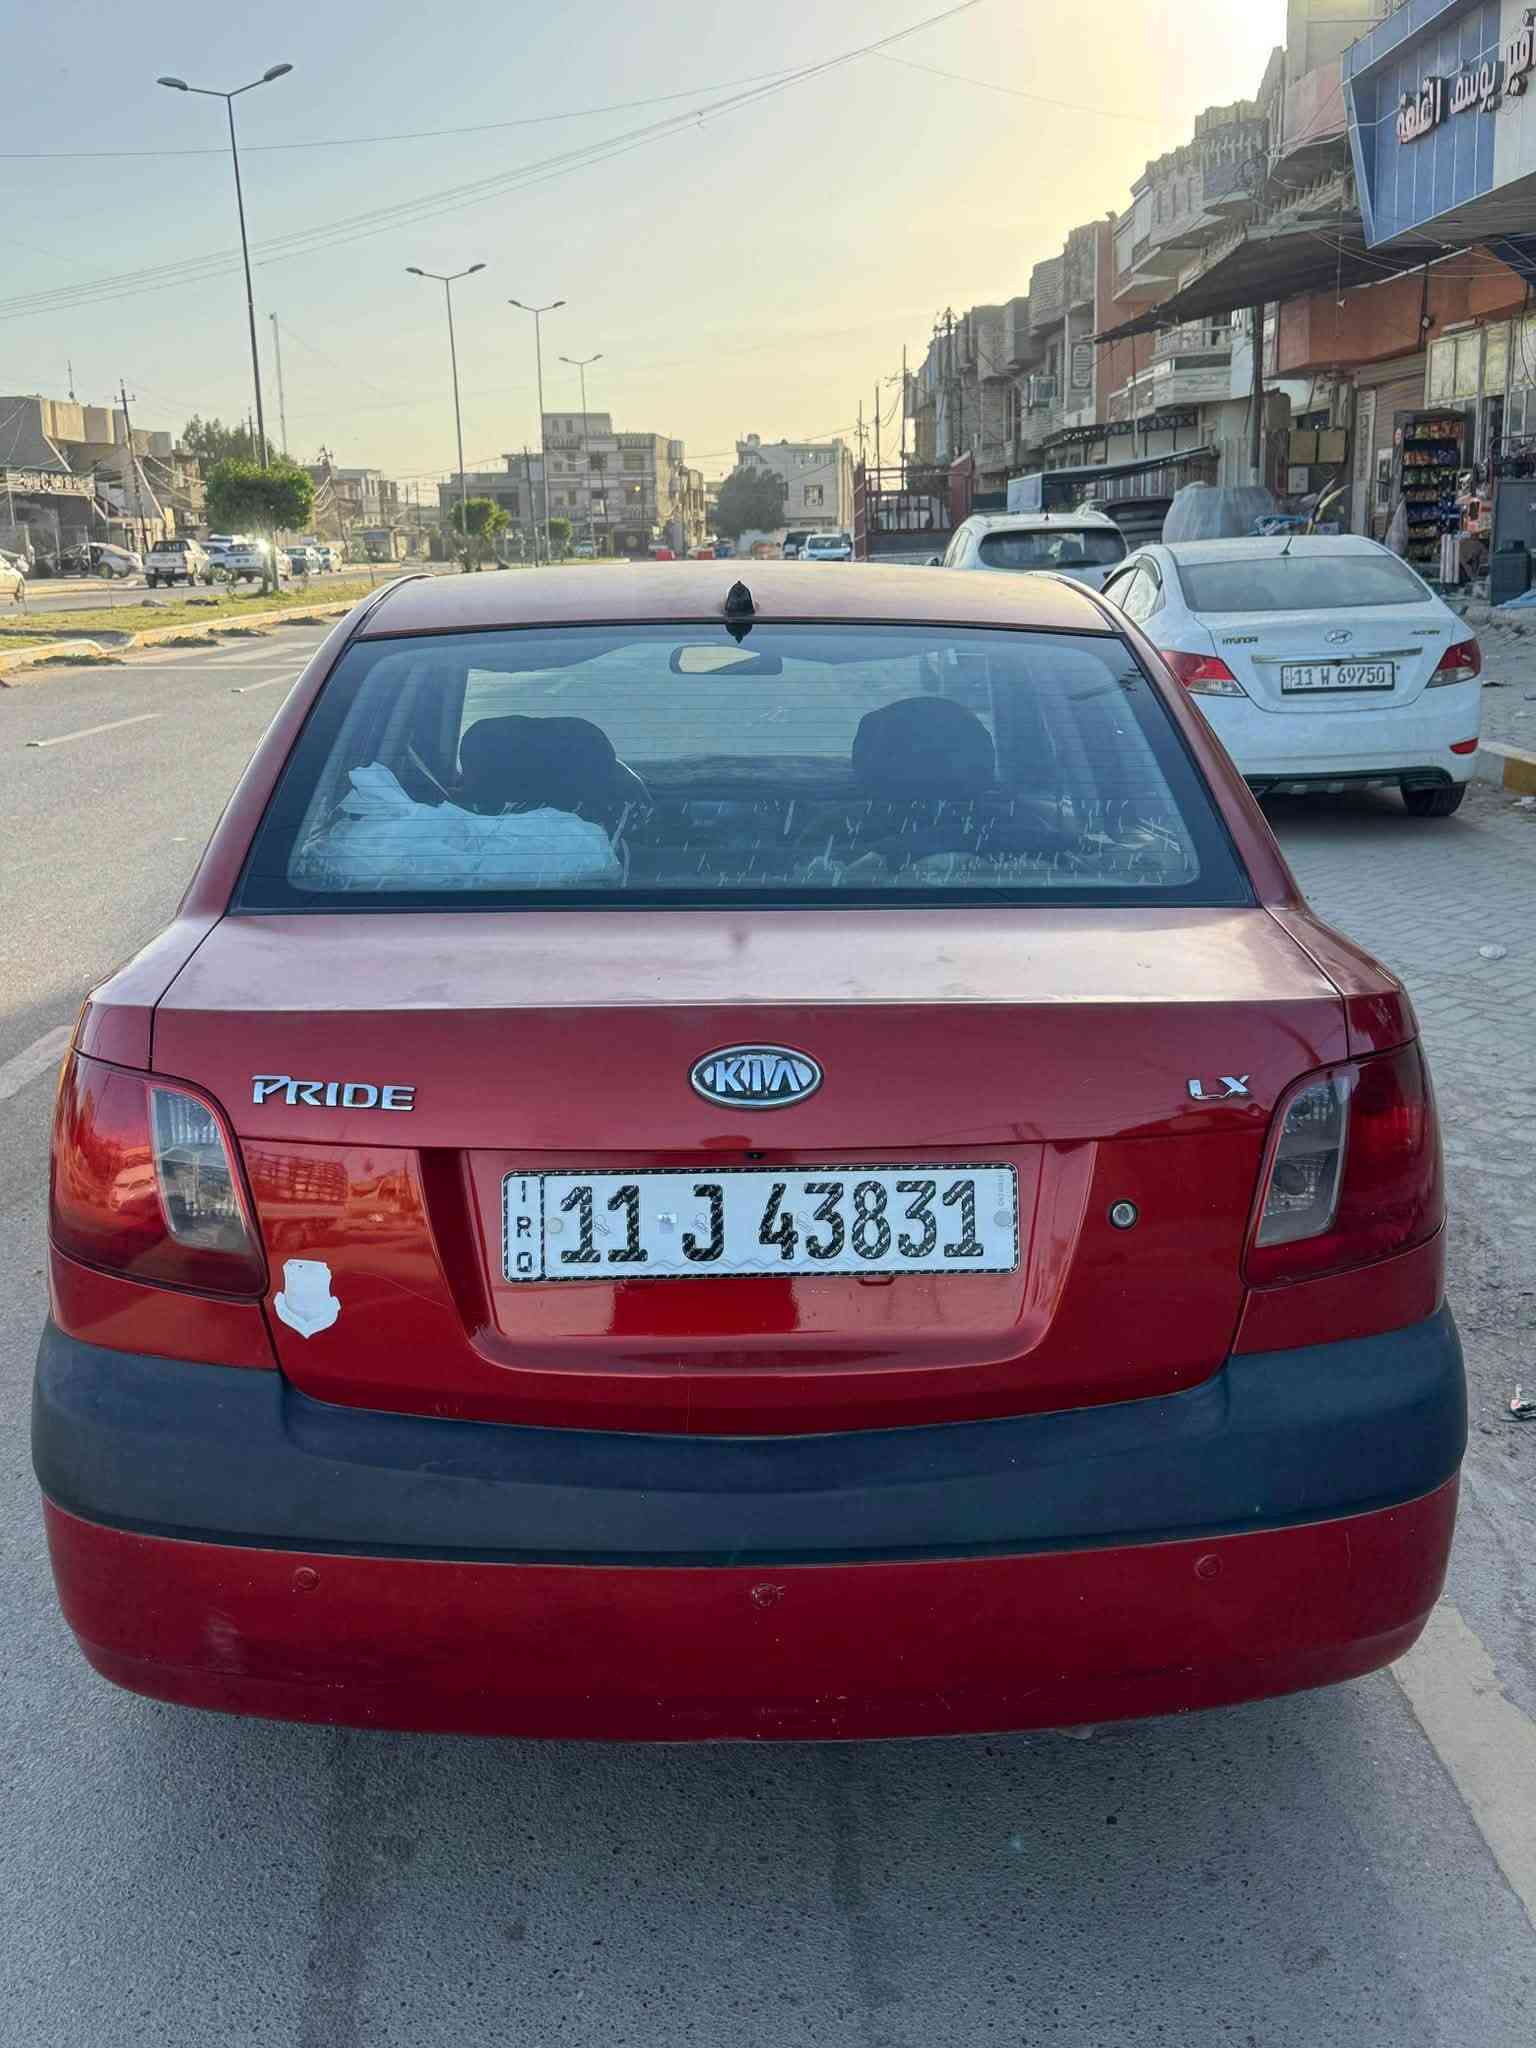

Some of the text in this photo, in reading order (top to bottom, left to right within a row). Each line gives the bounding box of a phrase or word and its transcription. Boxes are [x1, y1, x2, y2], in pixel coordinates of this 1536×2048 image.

[1450, 61, 1497, 113] يوسف
[1294, 668, 1313, 686] 11
[1336, 666, 1386, 685] 69750
[251, 1074, 416, 1111] PRIDE
[714, 1059, 801, 1092] KIA
[1187, 1073, 1250, 1100] LX
[560, 1184, 648, 1263] 11
[682, 1183, 724, 1262] J
[758, 1179, 985, 1261] 43831
